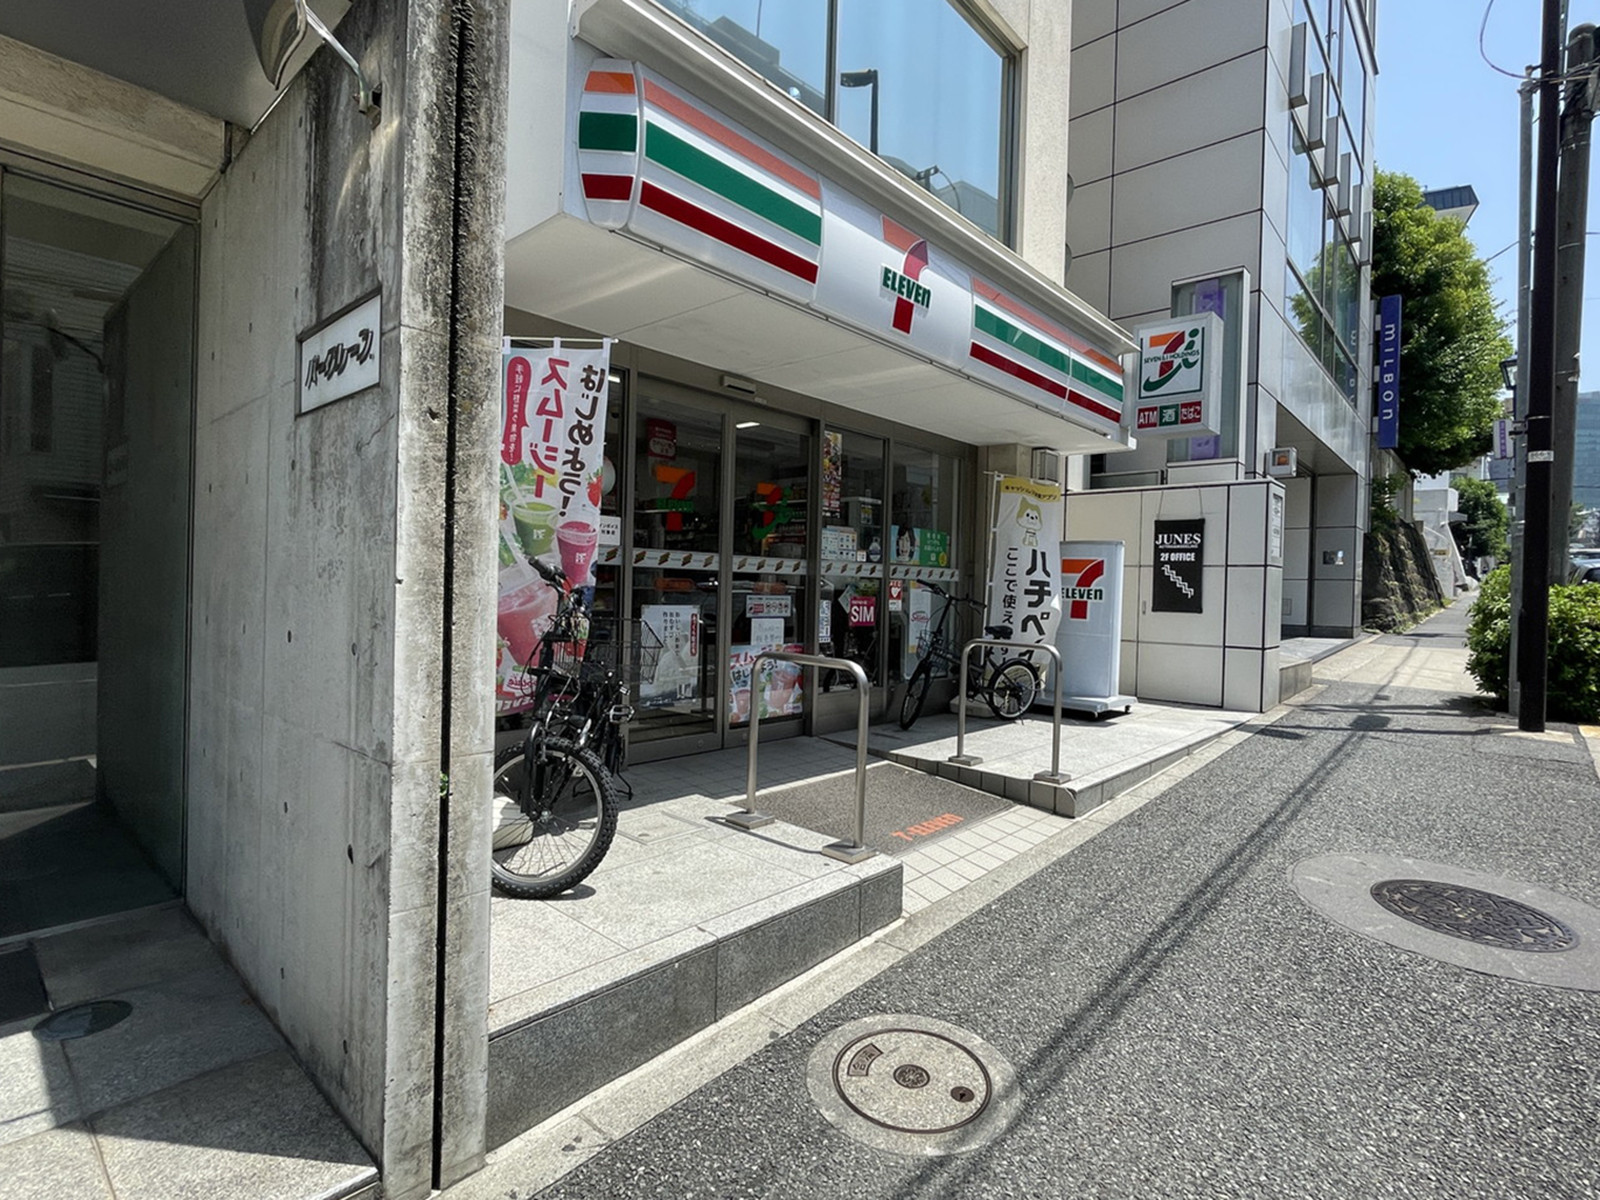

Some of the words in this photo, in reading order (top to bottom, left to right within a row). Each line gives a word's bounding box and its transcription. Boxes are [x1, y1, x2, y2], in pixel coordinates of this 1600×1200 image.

[1138, 411, 1157, 425] ATM
[1162, 408, 1176, 422] 酒
[1181, 405, 1201, 420] たばこ
[1155, 532, 1201, 545] JUNES
[1170, 552, 1195, 561] OFFICE
[851, 605, 874, 623] SIM
